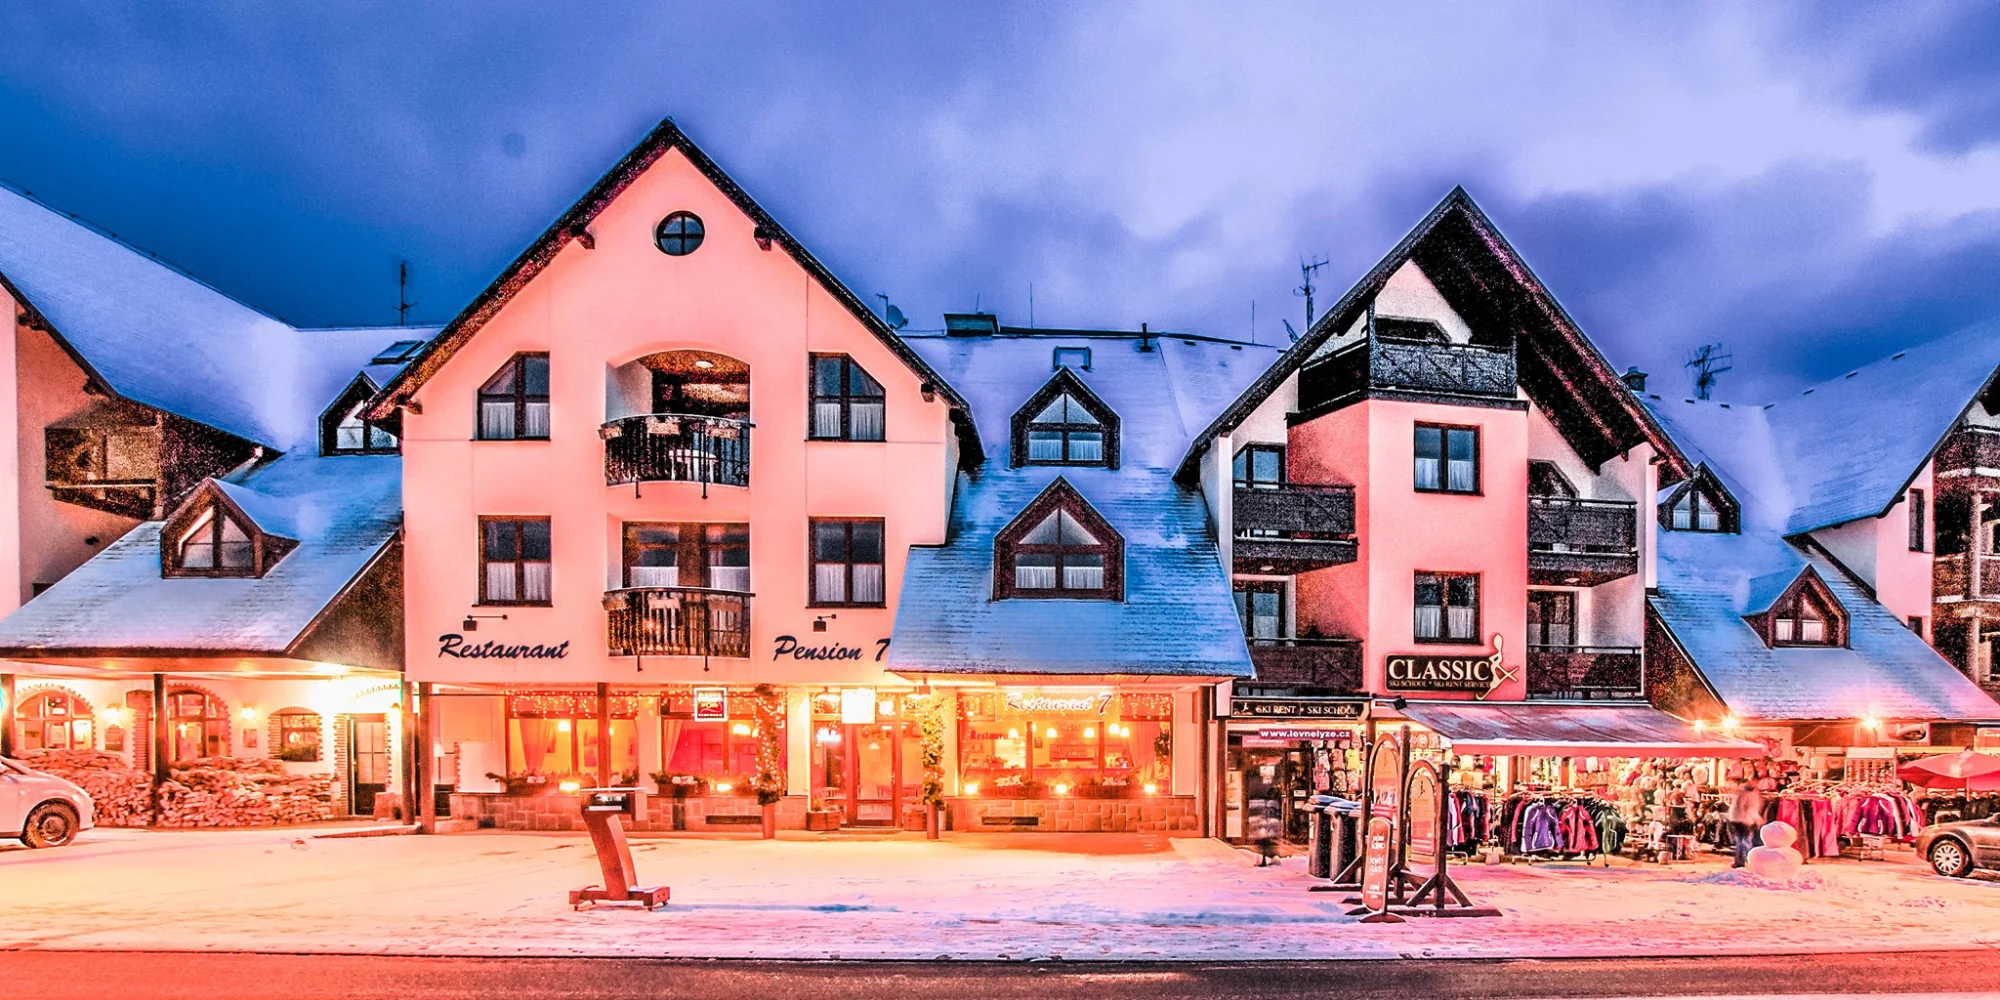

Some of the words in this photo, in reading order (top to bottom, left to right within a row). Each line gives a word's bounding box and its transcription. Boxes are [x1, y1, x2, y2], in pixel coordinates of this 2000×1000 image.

[438, 633, 570, 659] Restaurant
[773, 635, 863, 661] Pension
[875, 637, 892, 662] 7
[1388, 659, 1490, 681] CLASSIC
[1005, 693, 1093, 712] Restaurant
[1098, 691, 1114, 715] 7
[1255, 704, 1272, 714] SKI
[1273, 705, 1297, 715] RENT
[1307, 705, 1322, 715] SKI
[1323, 704, 1358, 716] SCHOOL
[1260, 730, 1351, 739] www.levnelyze.cz
